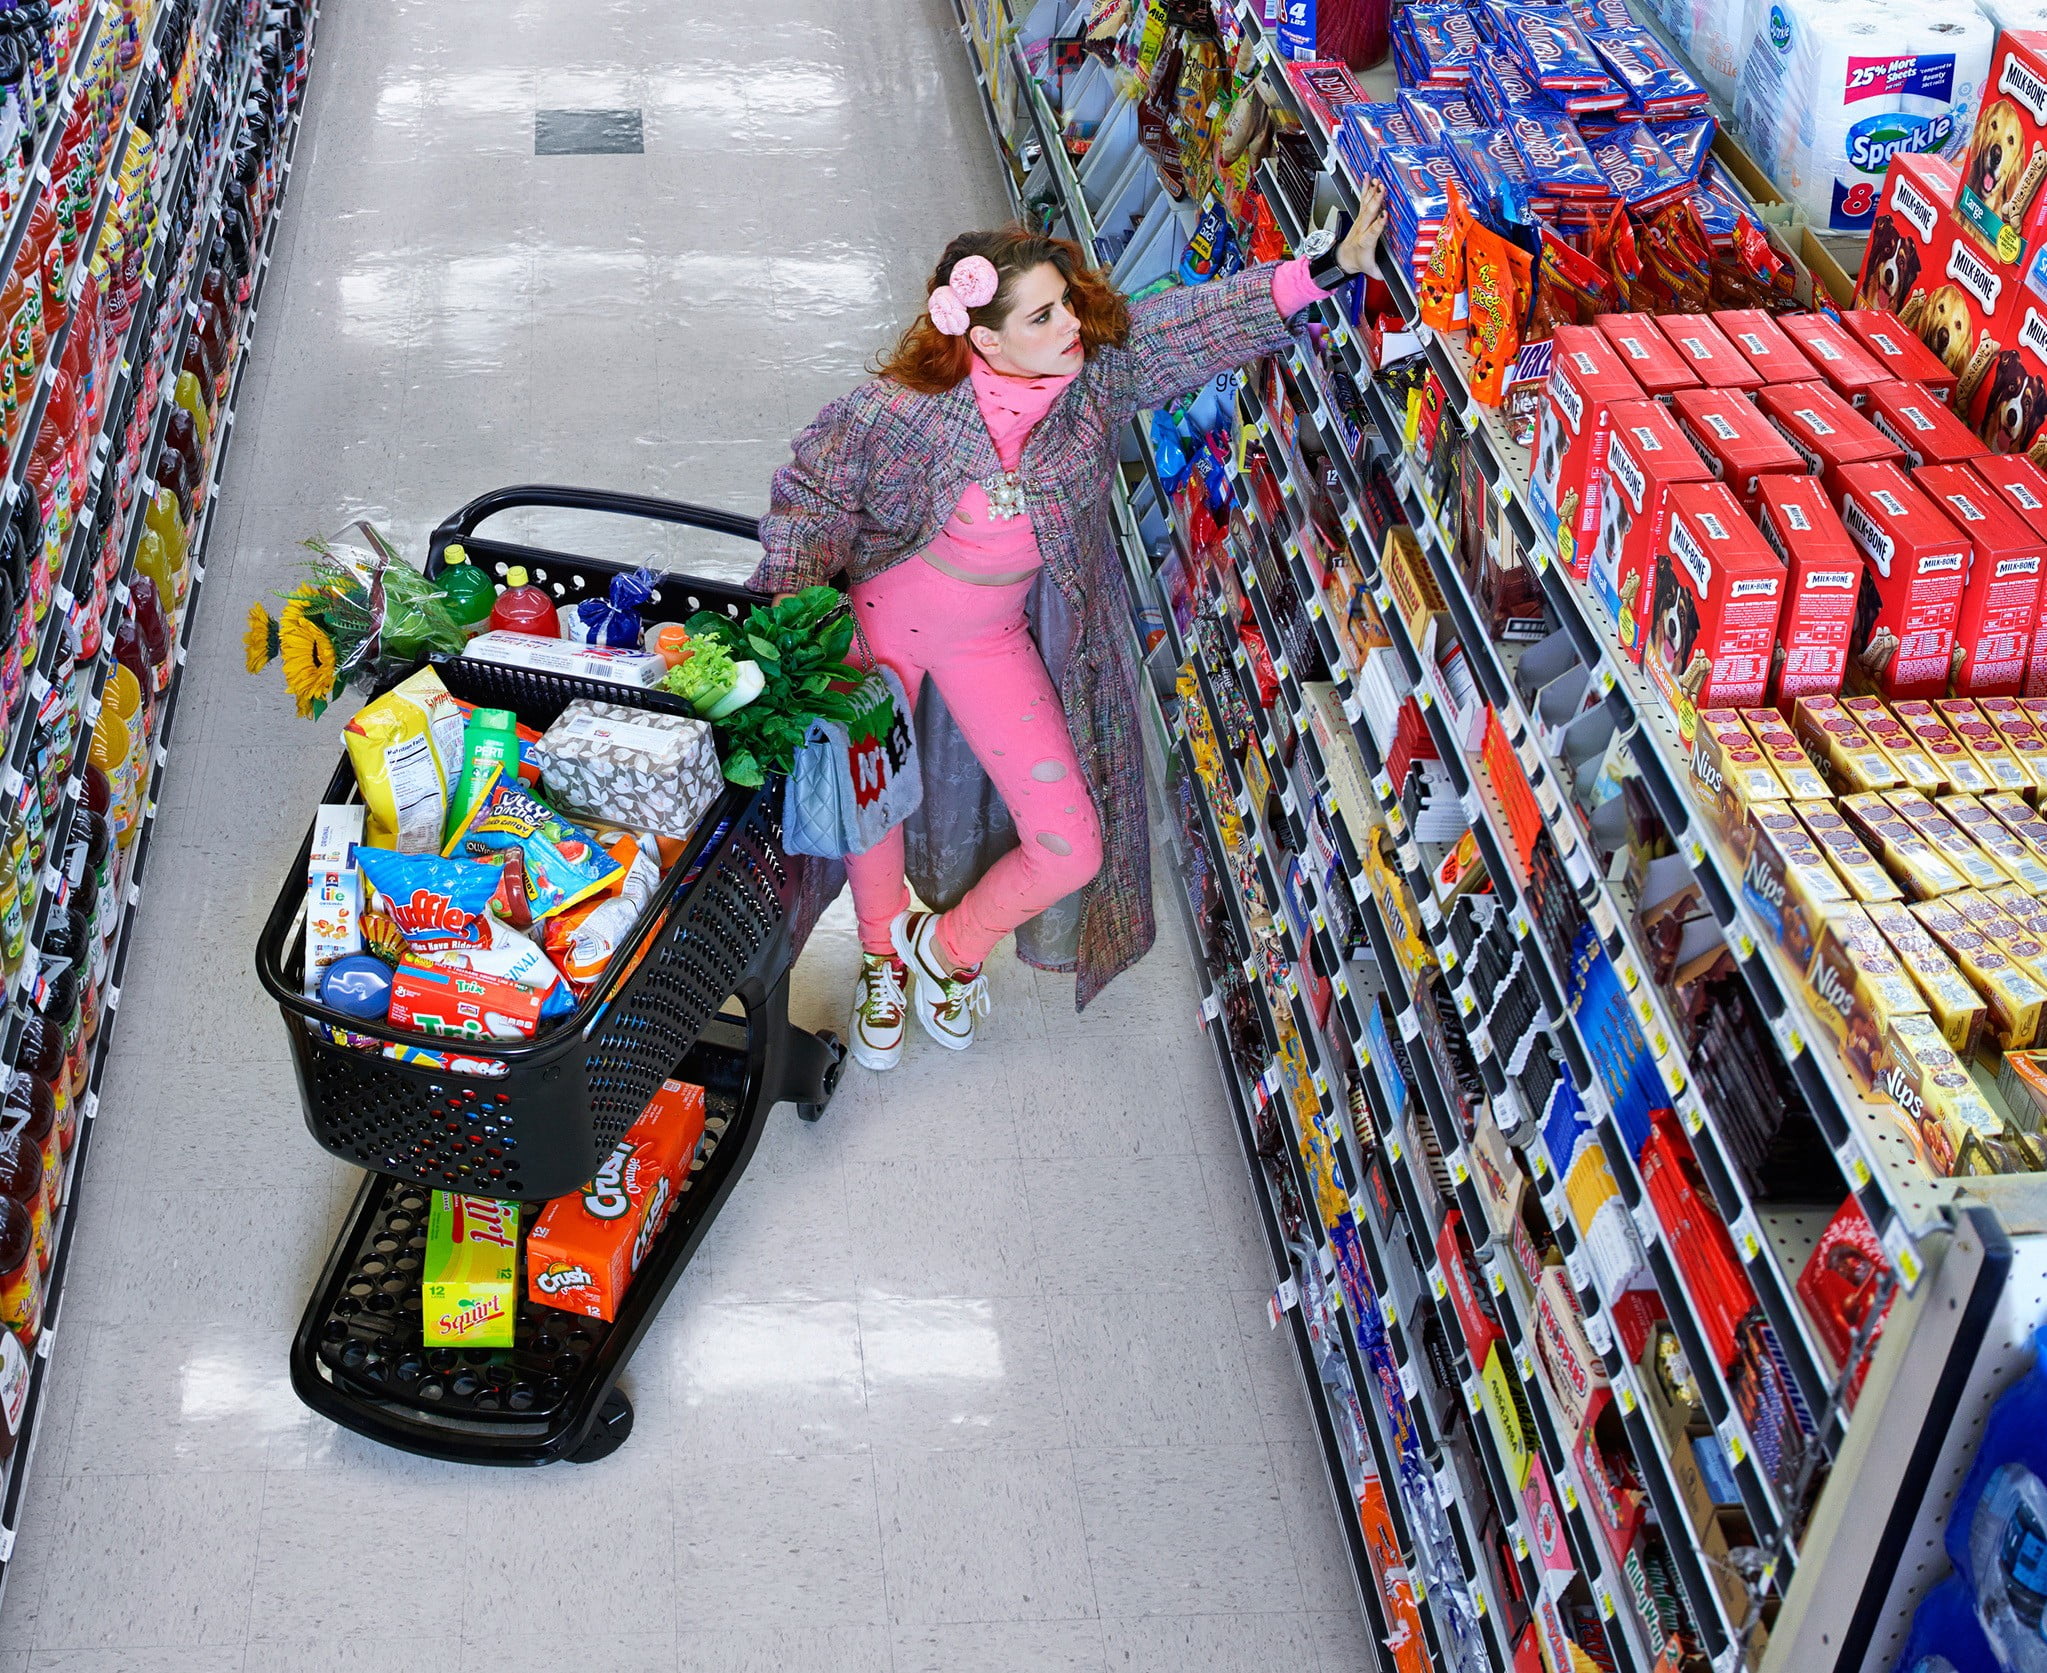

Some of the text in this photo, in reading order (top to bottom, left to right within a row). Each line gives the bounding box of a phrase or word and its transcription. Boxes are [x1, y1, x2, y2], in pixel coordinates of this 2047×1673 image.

[1289, 3, 1307, 20] 4
[1289, 18, 1307, 26] LBS
[1846, 58, 1917, 88] 25% More
[1886, 68, 1917, 83] Sheets
[1850, 116, 1952, 170] Sparkle
[1842, 182, 1875, 216] 8
[1964, 191, 1985, 220] Large
[1326, 469, 1338, 481] 12
[1672, 525, 1707, 584] MILK-BONE
[1649, 651, 1674, 698] Medium
[1690, 741, 1723, 793] Nips
[1744, 852, 1787, 907] Nips
[456, 979, 486, 994] Trix
[1808, 953, 1856, 1016] Nips
[1350, 1083, 1376, 1140] HEATH
[625, 1157, 641, 1194] Orange
[533, 1226, 548, 1238] 12
[631, 1176, 670, 1275] Crush
[499, 1266, 512, 1280] 12
[537, 1265, 592, 1293] Crush
[429, 1285, 446, 1296] 12
[439, 1294, 501, 1335] Squirt
[585, 1305, 601, 1316] 12
[1539, 1288, 1587, 1395] WHOPPERS
